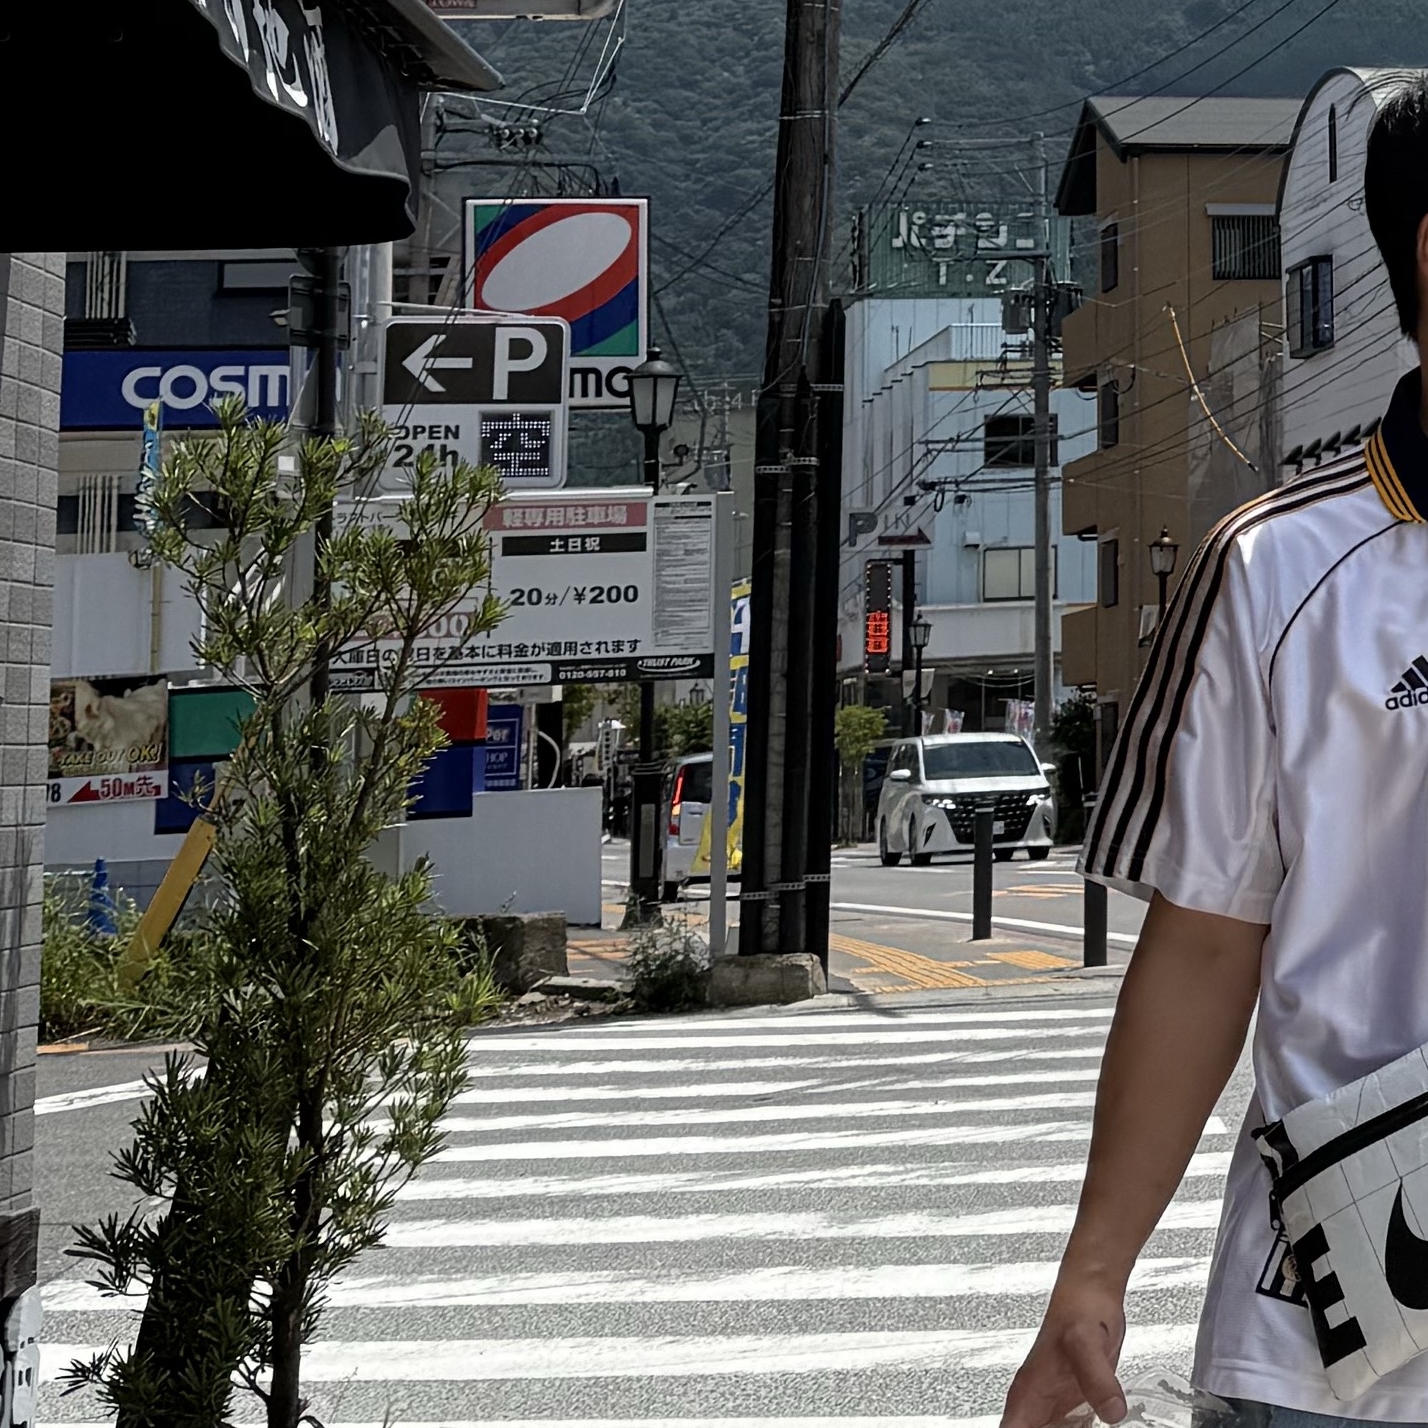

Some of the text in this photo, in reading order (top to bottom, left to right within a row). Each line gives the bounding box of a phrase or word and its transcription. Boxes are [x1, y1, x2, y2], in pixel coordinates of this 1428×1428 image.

[492, 327, 548, 400] P
[393, 424, 460, 441] OPEN
[481, 413, 550, 477] 空
[502, 505, 628, 527] 軽専用駐車場
[549, 537, 601, 553] 土日祝
